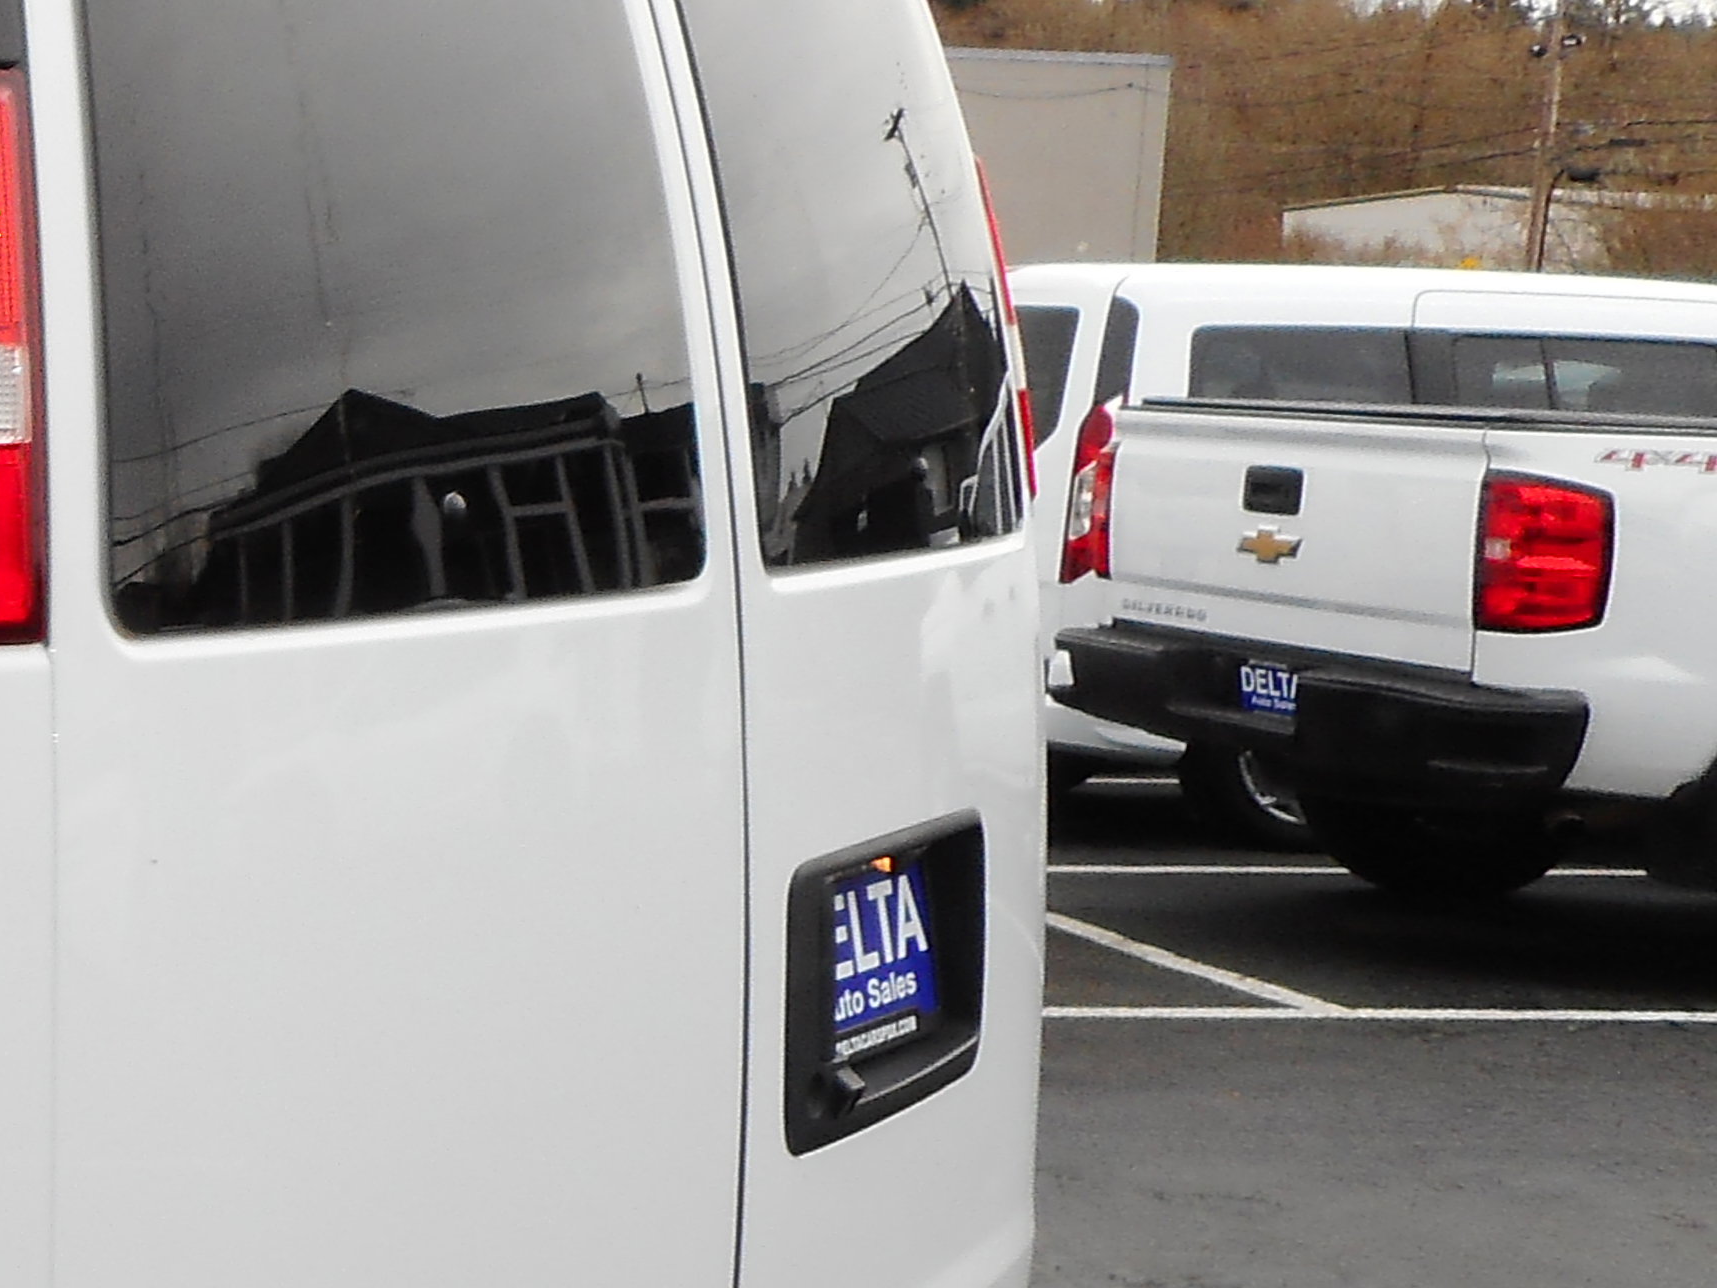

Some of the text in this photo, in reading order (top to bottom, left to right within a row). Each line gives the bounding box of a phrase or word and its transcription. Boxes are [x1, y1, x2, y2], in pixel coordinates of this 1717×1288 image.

[834, 874, 929, 980] ELTA
[834, 971, 917, 1022] uto Sales
